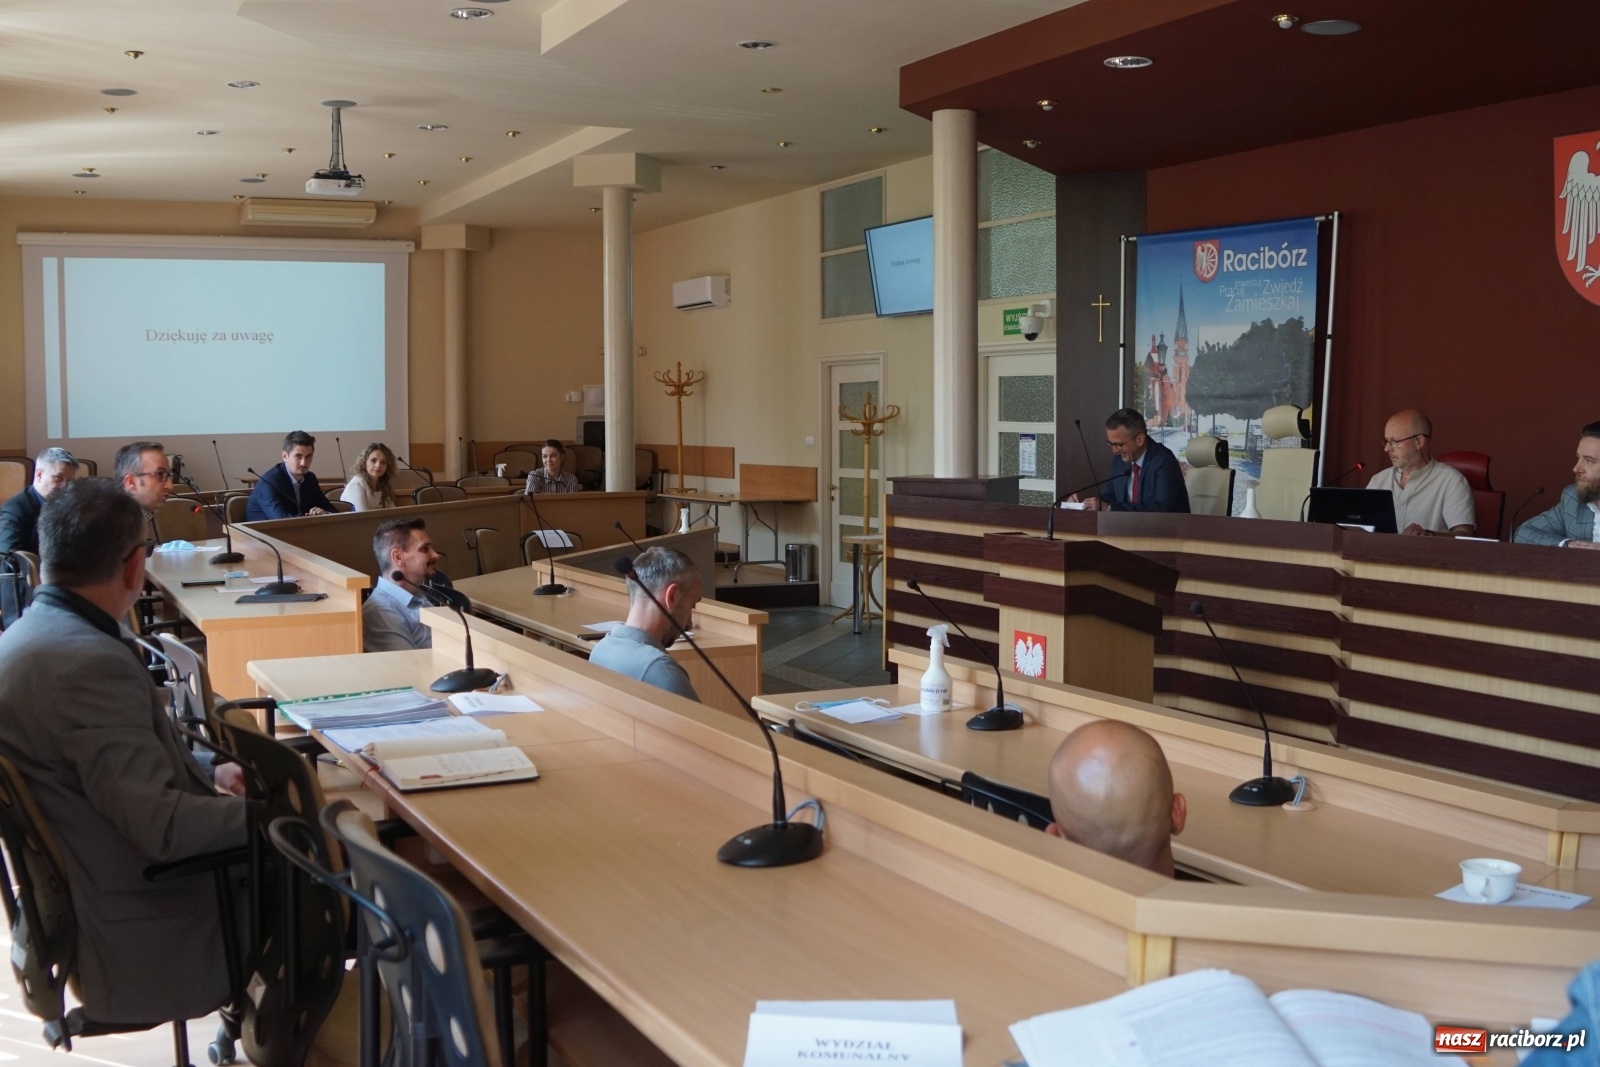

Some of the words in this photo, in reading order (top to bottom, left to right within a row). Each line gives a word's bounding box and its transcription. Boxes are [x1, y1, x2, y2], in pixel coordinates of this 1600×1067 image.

[1223, 241, 1307, 272] Racibórz
[1219, 284, 1245, 297] Pracuj
[1225, 293, 1300, 313] Zamieszkaj
[145, 328, 207, 344] Dziękuję
[211, 331, 227, 341] za
[231, 331, 274, 344] uwagę
[797, 1049, 911, 1062] KOMUNALNY
